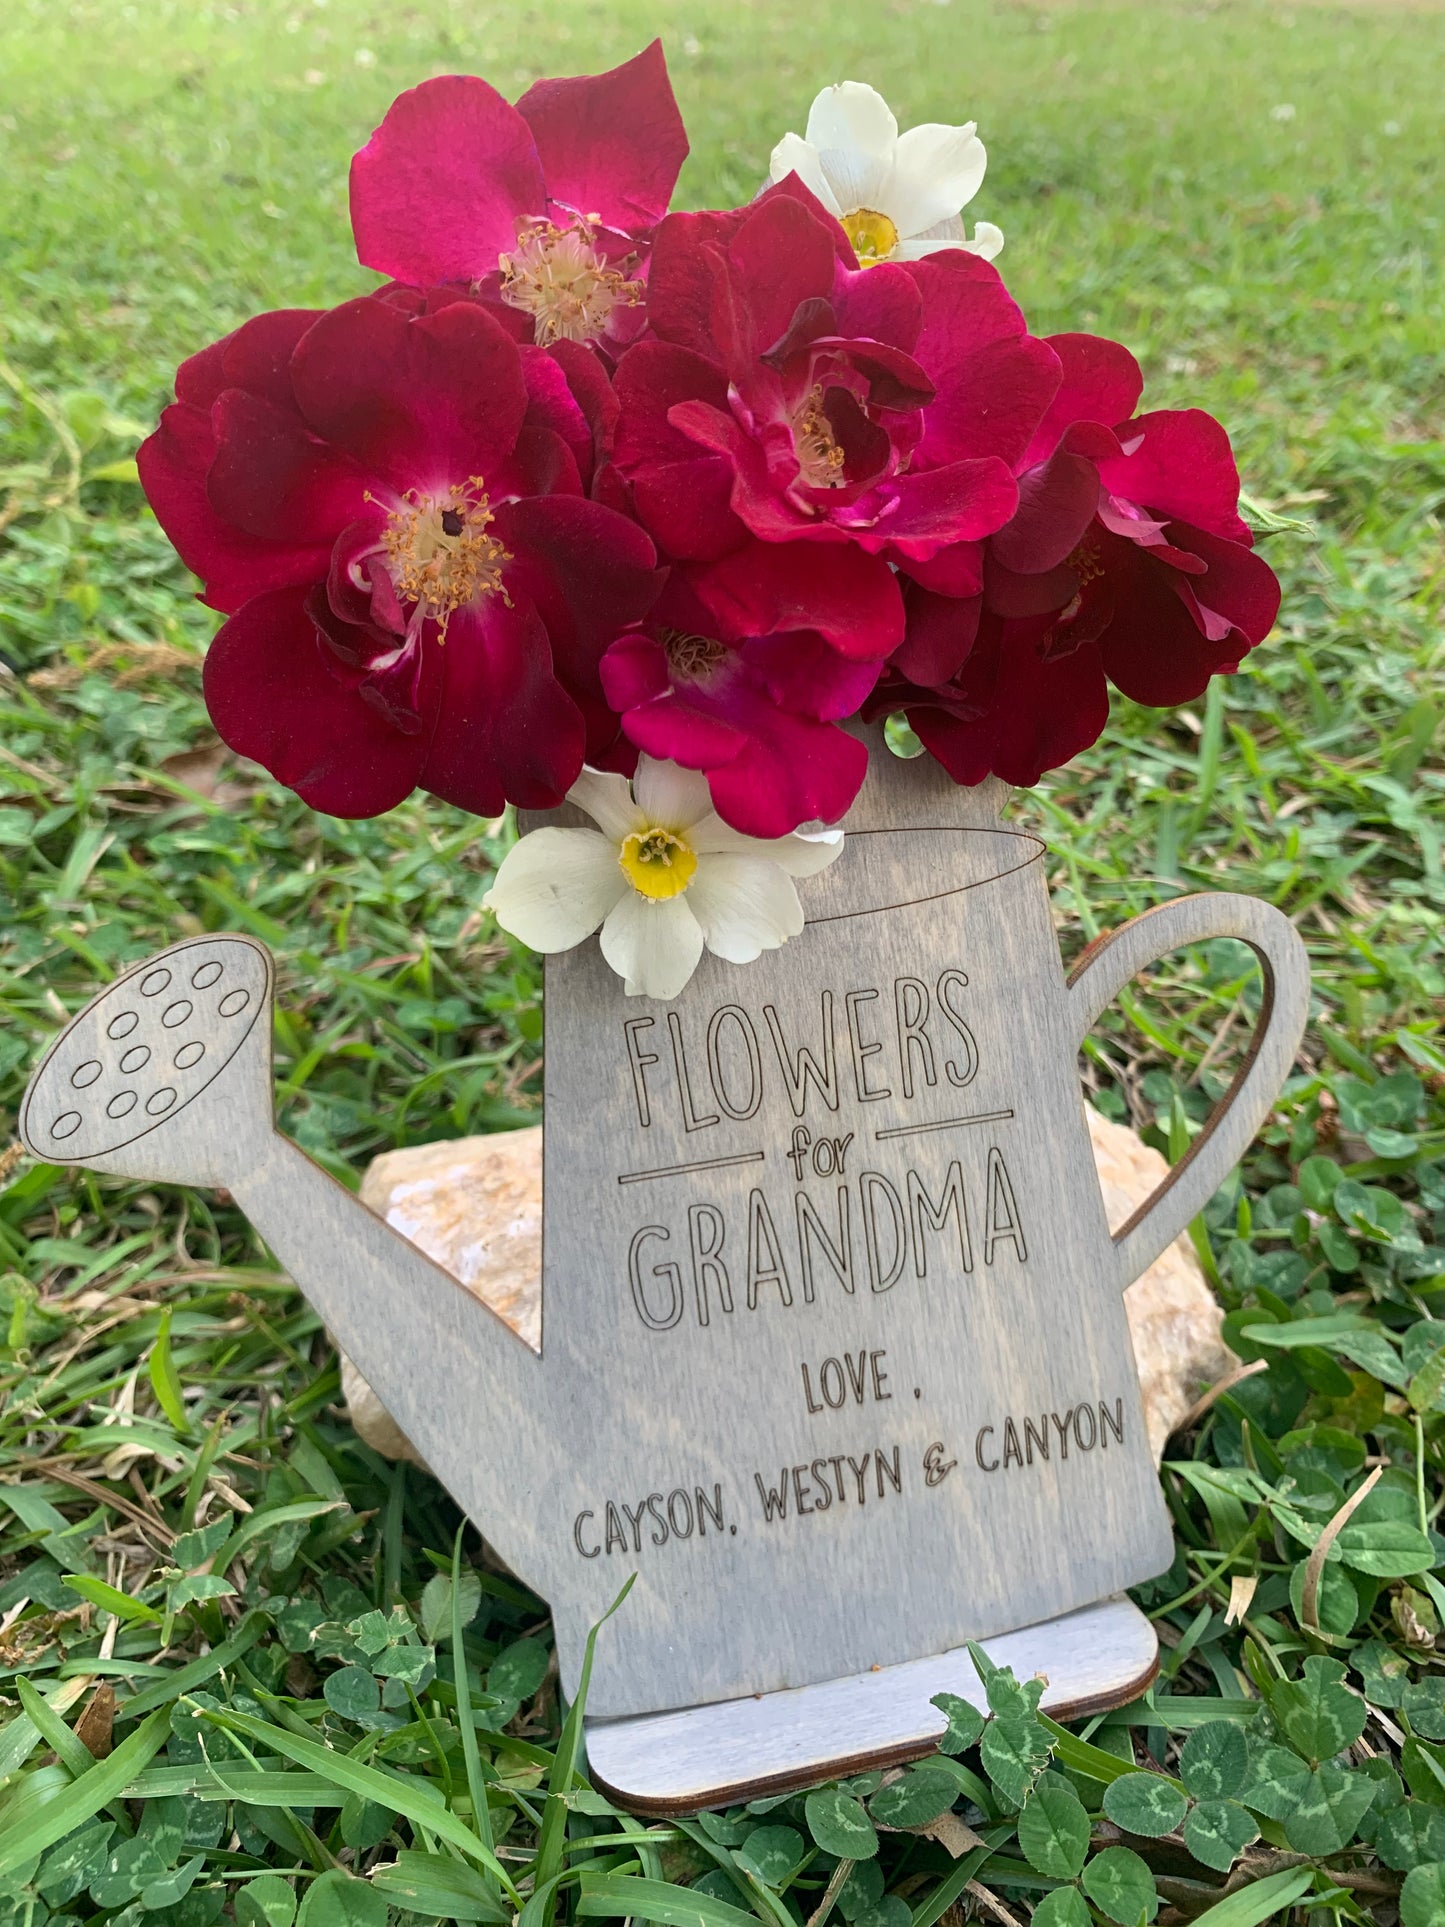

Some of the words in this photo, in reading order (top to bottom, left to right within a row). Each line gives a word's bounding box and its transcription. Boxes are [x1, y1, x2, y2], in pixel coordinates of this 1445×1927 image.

[624, 969, 980, 1133] FLOWERS
[787, 1125, 854, 1181] for
[628, 1147, 1028, 1331] GRANDMA
[754, 1445, 901, 1522] WESTYN
[922, 1442, 957, 1487] &
[975, 1397, 1124, 1472] CANYON
